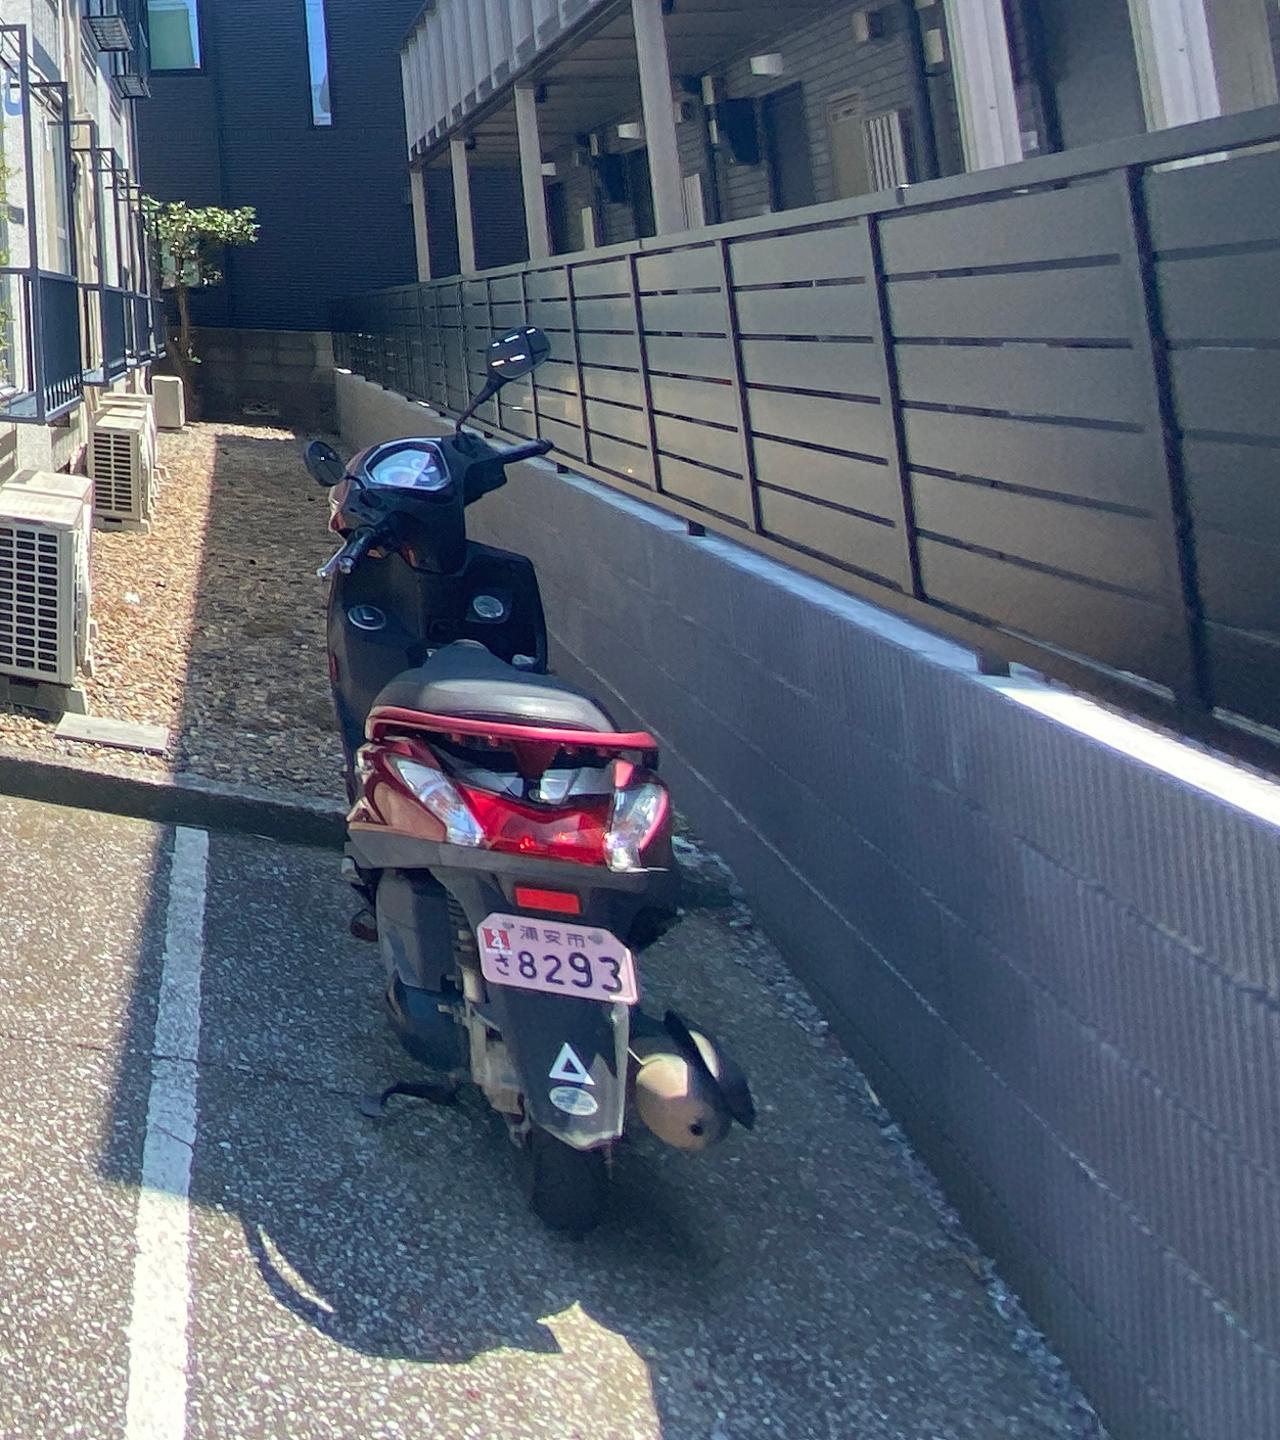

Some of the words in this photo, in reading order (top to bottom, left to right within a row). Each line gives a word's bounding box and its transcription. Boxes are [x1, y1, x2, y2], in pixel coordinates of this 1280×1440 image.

[519, 924, 586, 948] 浦安市
[517, 950, 623, 993] 8293
